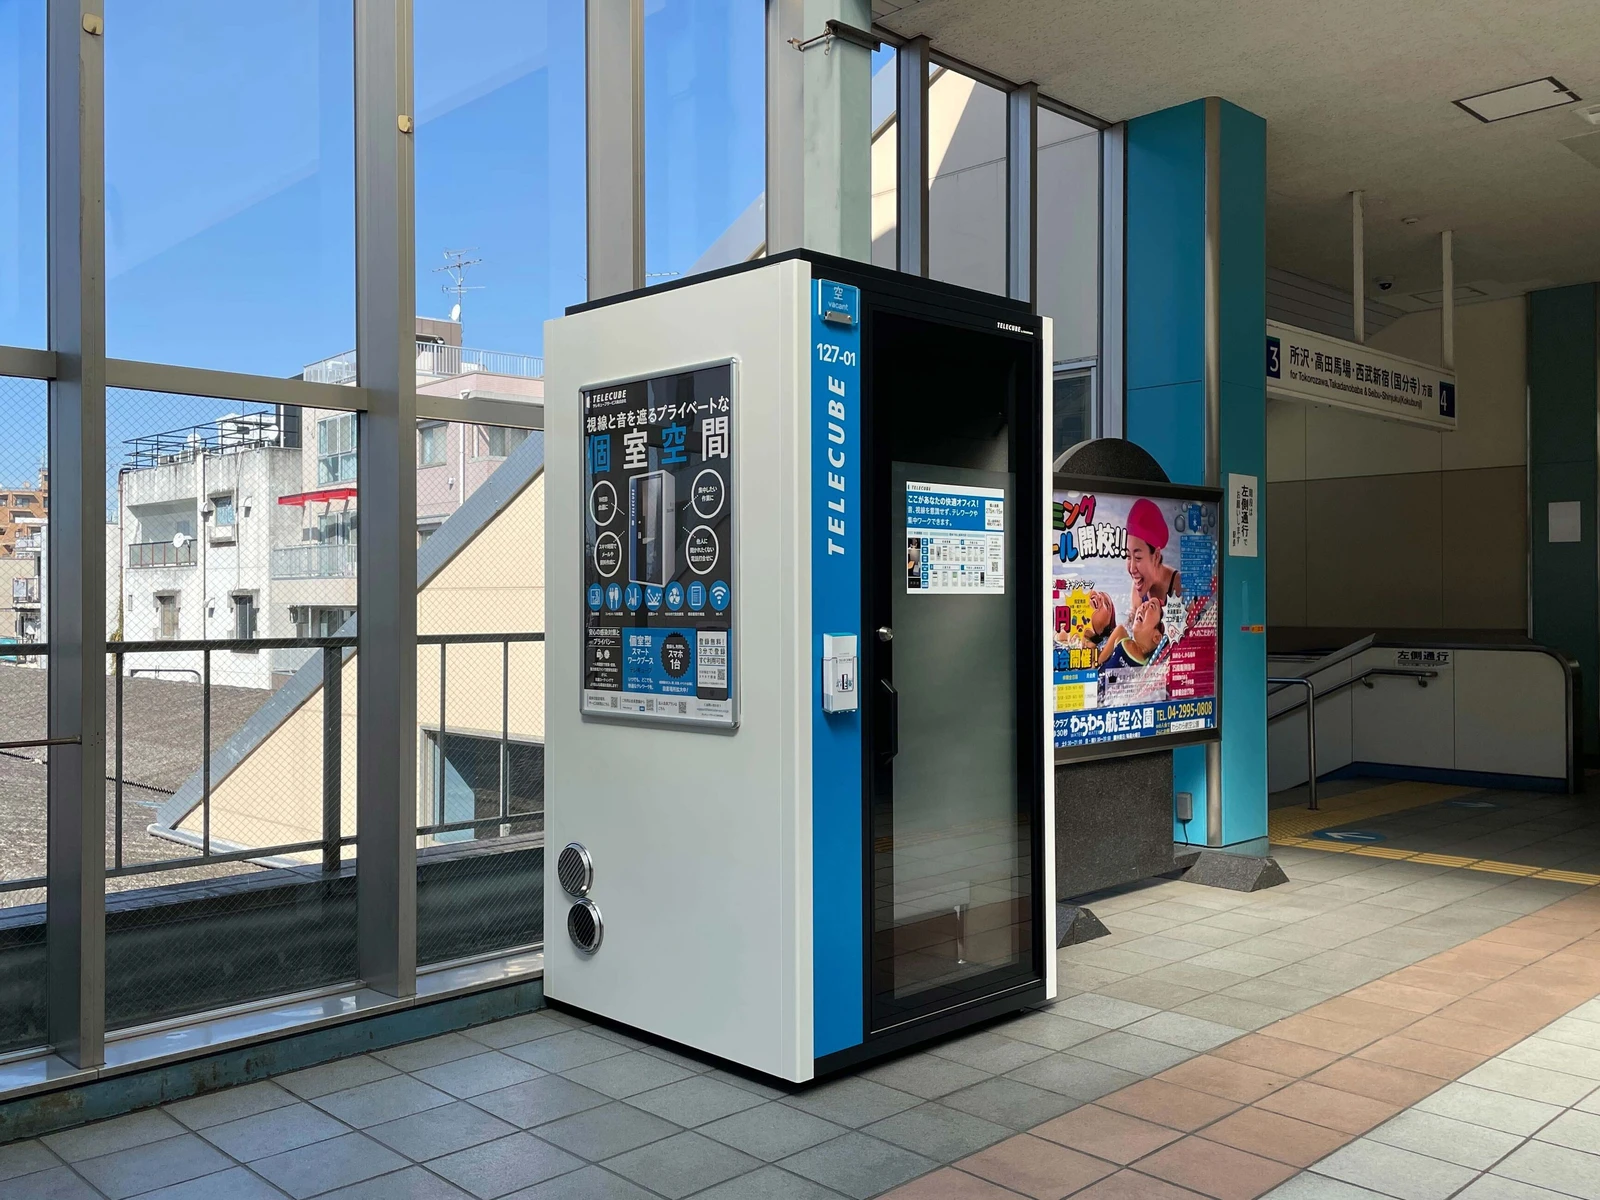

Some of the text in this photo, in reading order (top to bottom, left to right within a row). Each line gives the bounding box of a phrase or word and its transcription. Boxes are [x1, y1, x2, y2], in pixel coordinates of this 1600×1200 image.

[833, 286, 844, 300] 空
[828, 301, 849, 311] vacant
[996, 321, 1022, 333] TELECUBE
[816, 342, 856, 367] 127-01
[1269, 345, 1279, 373] 3
[1289, 369, 1298, 380] for
[1364, 387, 1368, 396] &
[592, 389, 627, 403] TELECUBE
[1440, 389, 1448, 412] 4
[587, 395, 729, 433] 視線と音を遮るプライベートな
[588, 415, 729, 474] 個室空間
[828, 375, 846, 556] TELECUBE
[629, 635, 652, 647] 個室型
[631, 647, 650, 656] スマート
[668, 650, 684, 659] スマホ
[1397, 650, 1450, 661] 左側通行
[627, 657, 654, 665] ワークブース
[669, 659, 681, 670] 1台
[1167, 701, 1213, 719] 04-2995-0808
